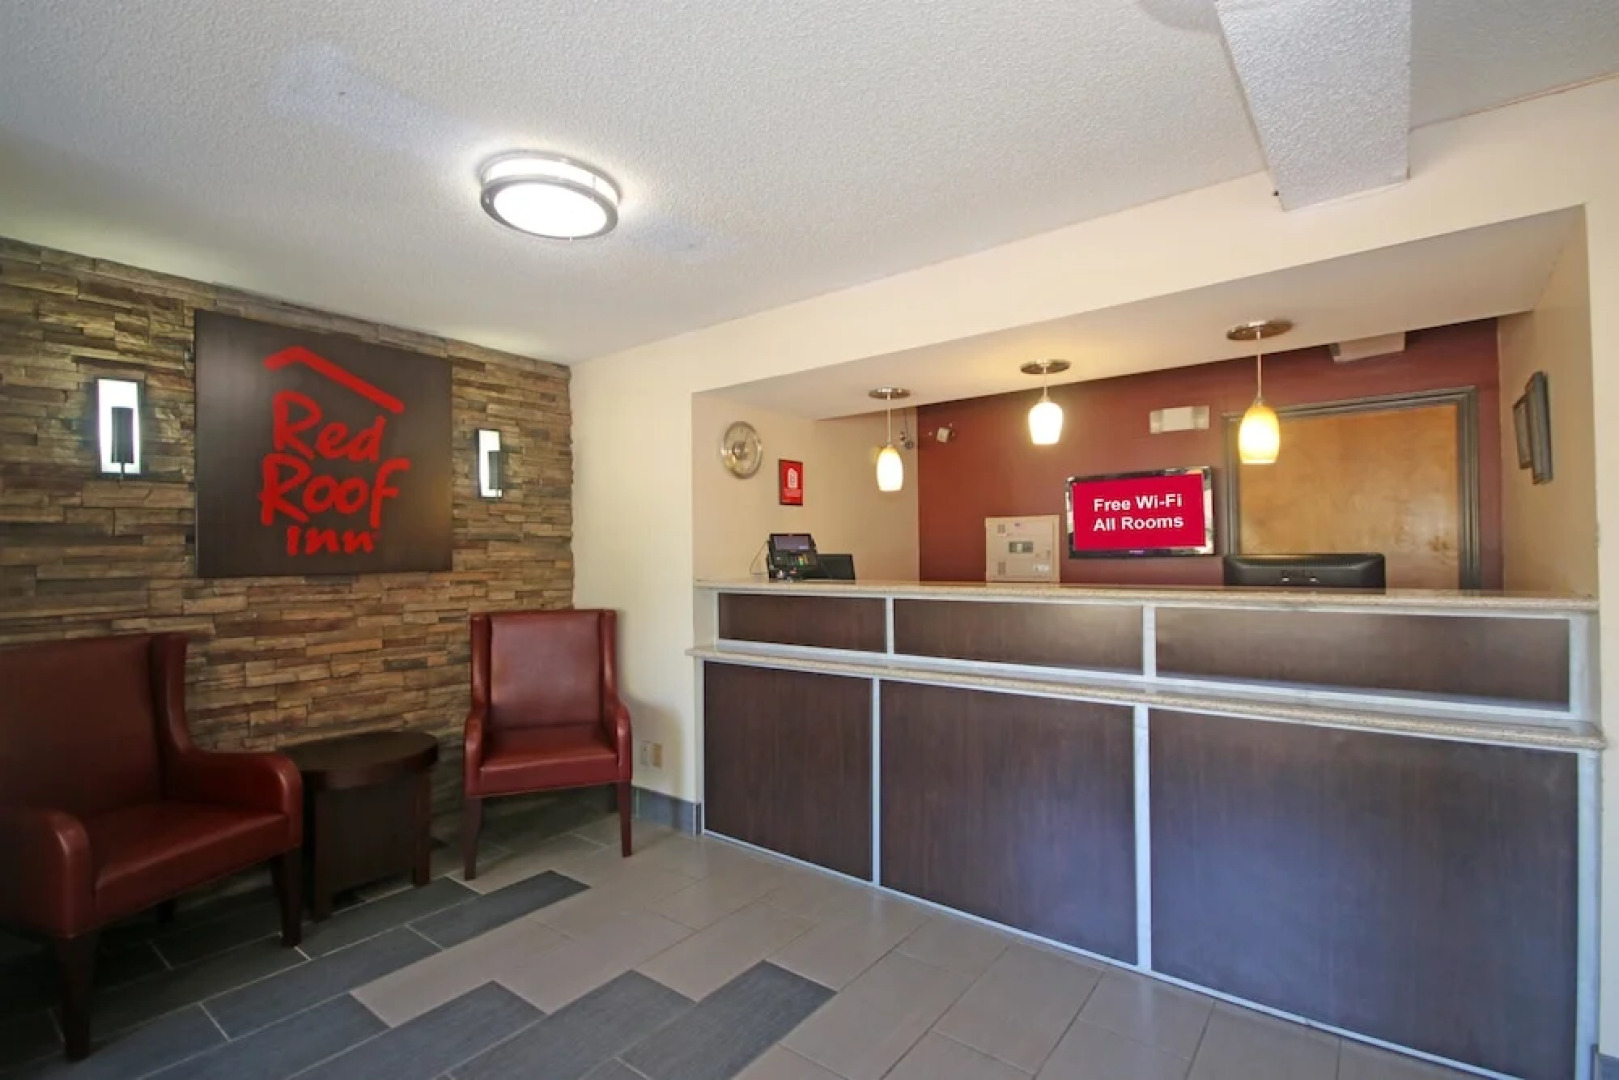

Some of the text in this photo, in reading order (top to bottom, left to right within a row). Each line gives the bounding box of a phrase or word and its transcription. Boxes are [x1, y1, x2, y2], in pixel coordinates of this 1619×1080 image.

[272, 390, 386, 462] Red
[258, 452, 411, 528] Roof
[1093, 493, 1183, 512] Free Wi-Fi
[1093, 515, 1184, 532] All Rooms
